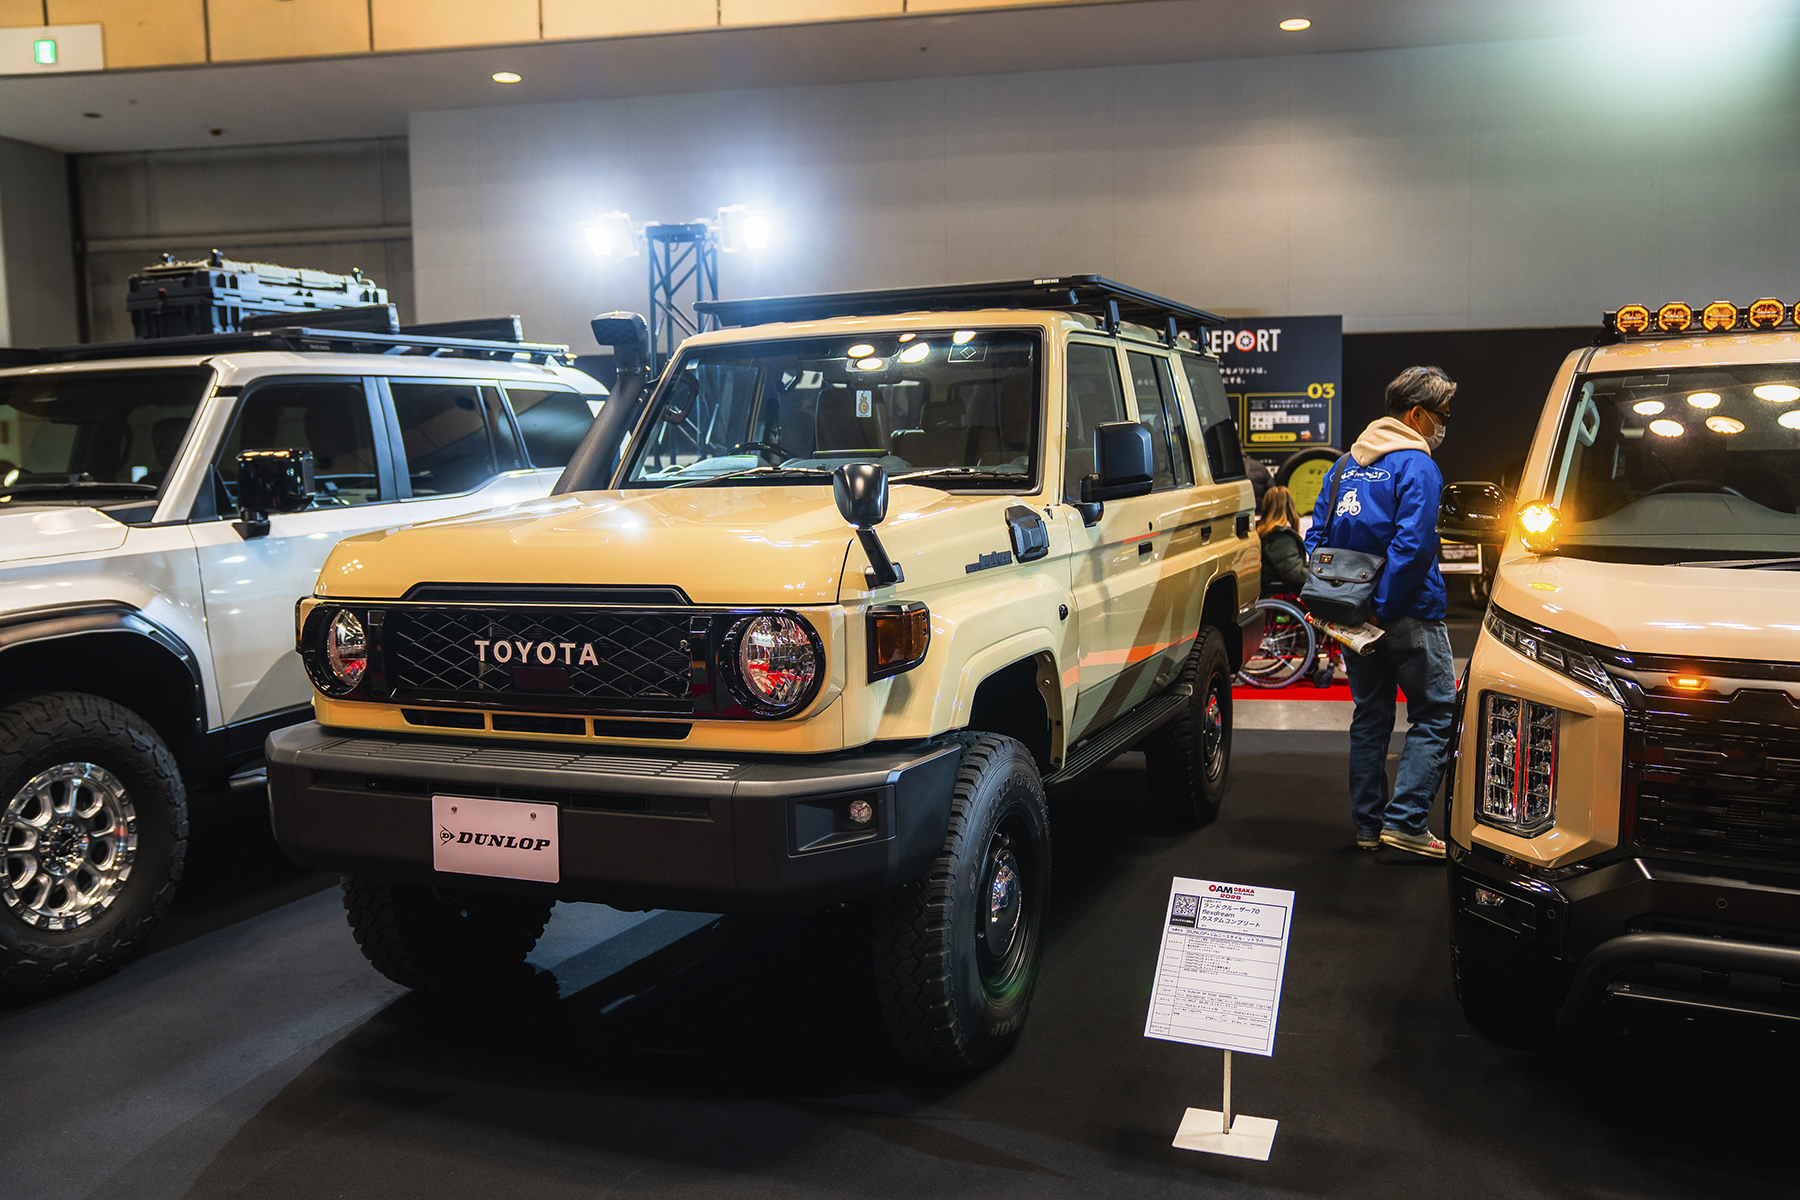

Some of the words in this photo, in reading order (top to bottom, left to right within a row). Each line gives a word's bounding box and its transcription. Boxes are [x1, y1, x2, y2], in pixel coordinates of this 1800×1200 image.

[1206, 328, 1282, 354] EPORT
[1307, 383, 1335, 399] 03
[474, 640, 599, 666] TOYOTA
[457, 831, 551, 851] DUNLOP
[1208, 884, 1233, 894] OAM
[1233, 886, 1255, 894] OSAKA
[1203, 902, 1261, 915] ランドクルーザー70
[1200, 915, 1261, 927] カスタムコンプリート
